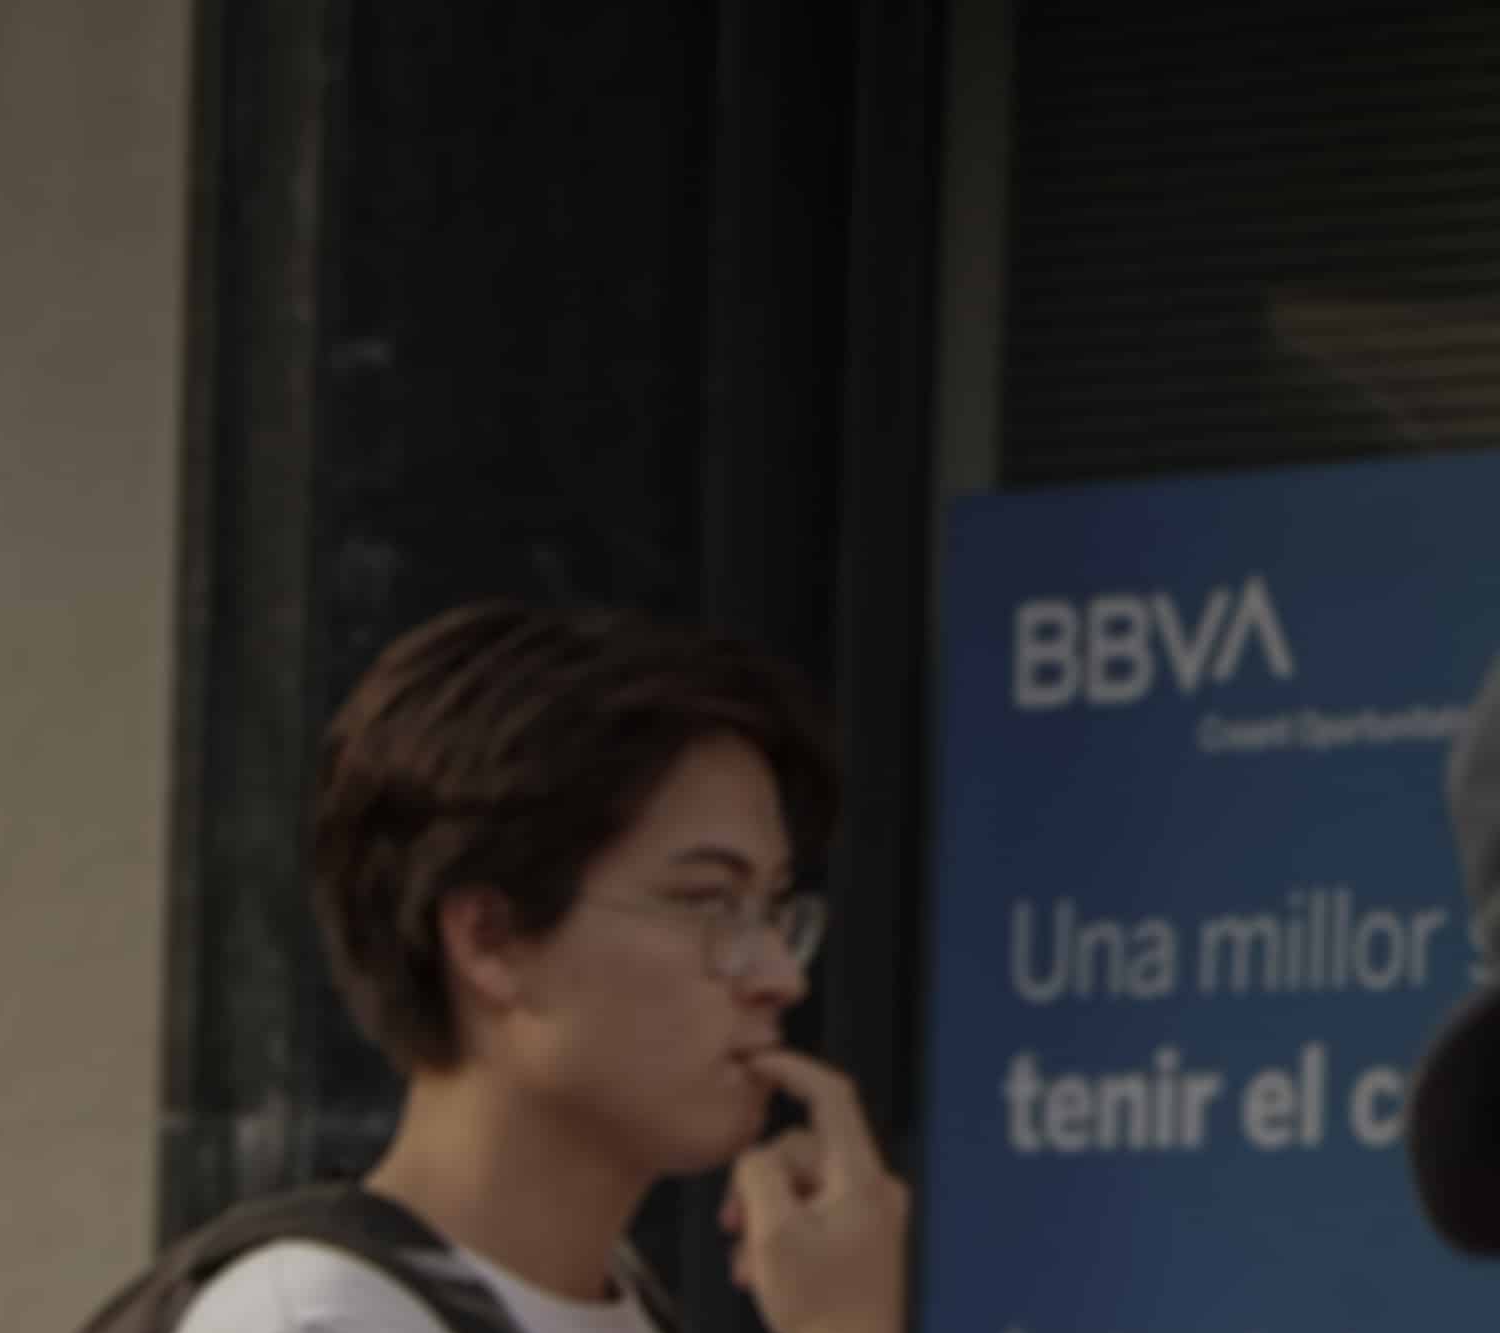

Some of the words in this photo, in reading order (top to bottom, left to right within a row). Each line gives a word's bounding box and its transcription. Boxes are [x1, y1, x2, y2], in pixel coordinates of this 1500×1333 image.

[1013, 575, 1296, 711] BBVA
[1012, 898, 1178, 1005] Una
[1200, 884, 1447, 994] millor
[1002, 1044, 1223, 1155] tenir
[1240, 1040, 1327, 1152] el
